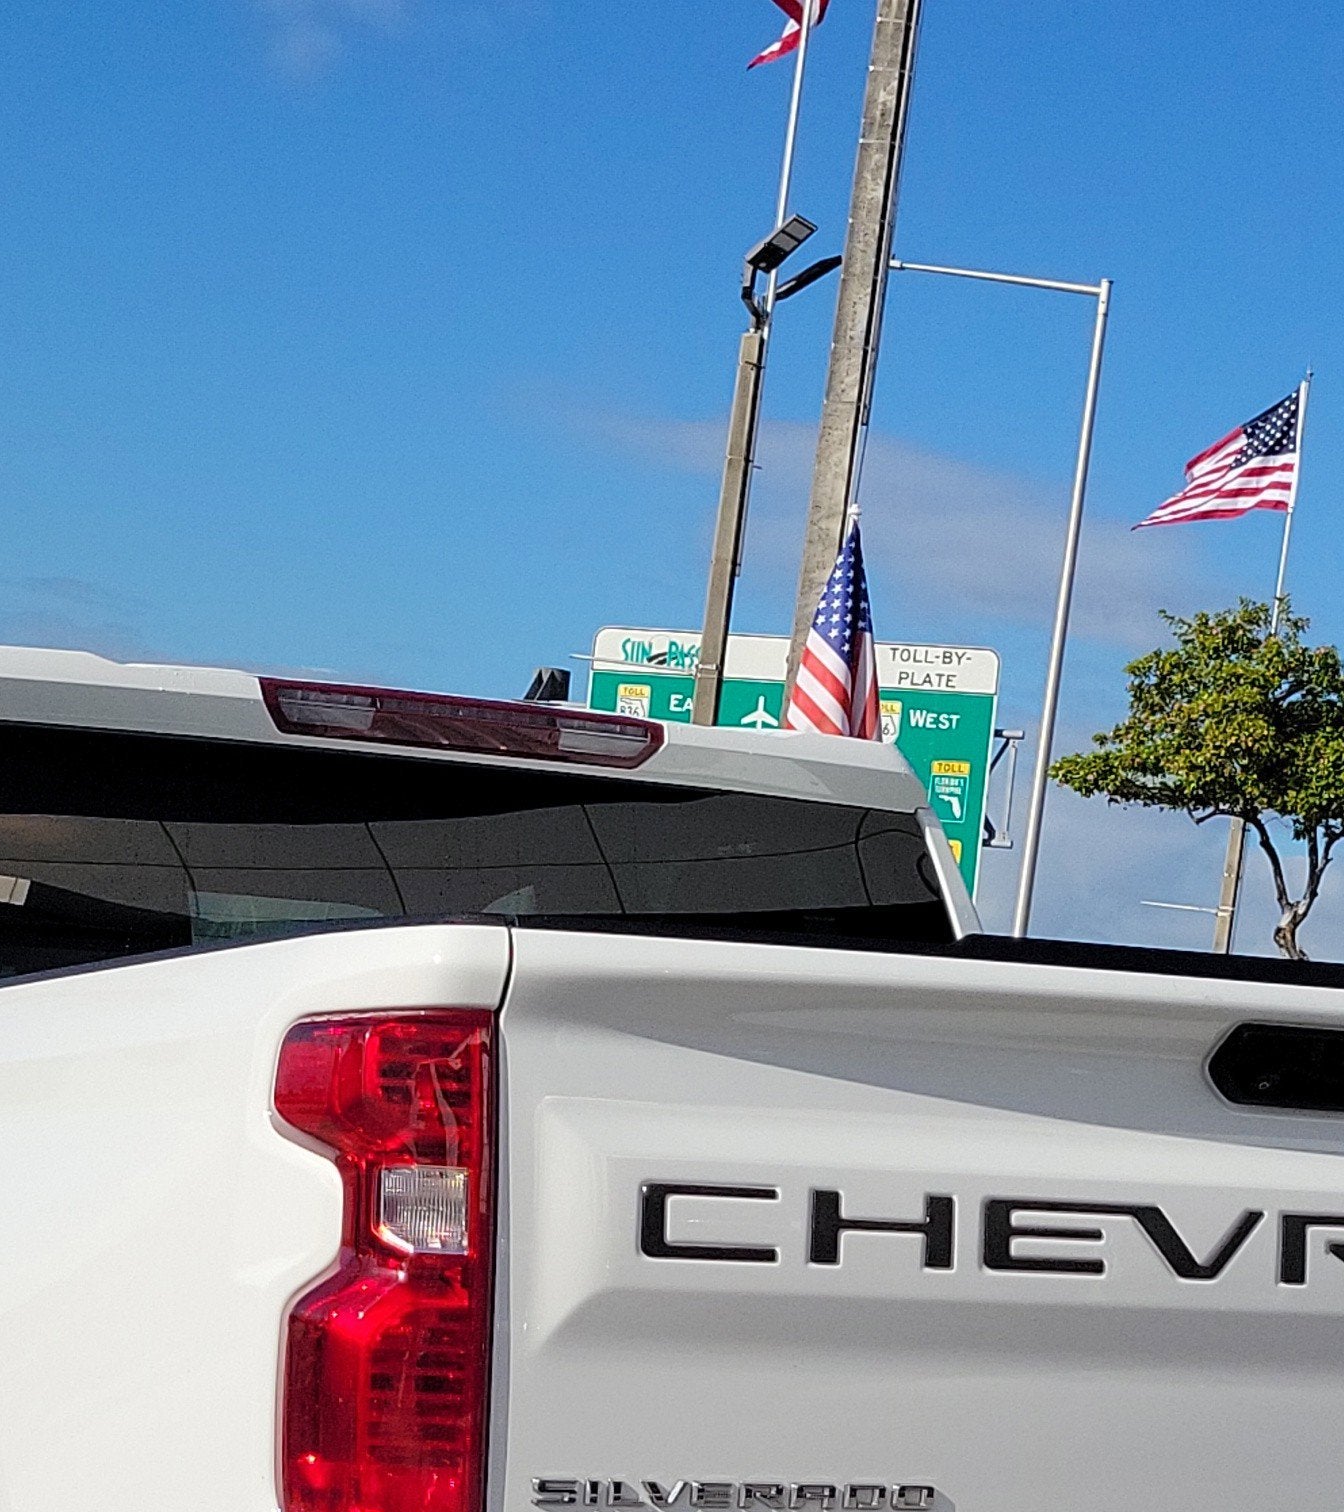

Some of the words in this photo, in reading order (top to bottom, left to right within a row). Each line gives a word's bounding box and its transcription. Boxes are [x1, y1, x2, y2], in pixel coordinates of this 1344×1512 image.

[890, 647, 972, 665] TOLL-BY-
[897, 671, 957, 688] PLATE
[623, 686, 646, 696] TOLL
[909, 709, 960, 729] WEST
[937, 762, 964, 773] TOLL
[531, 1477, 935, 1512] SILVERADO
